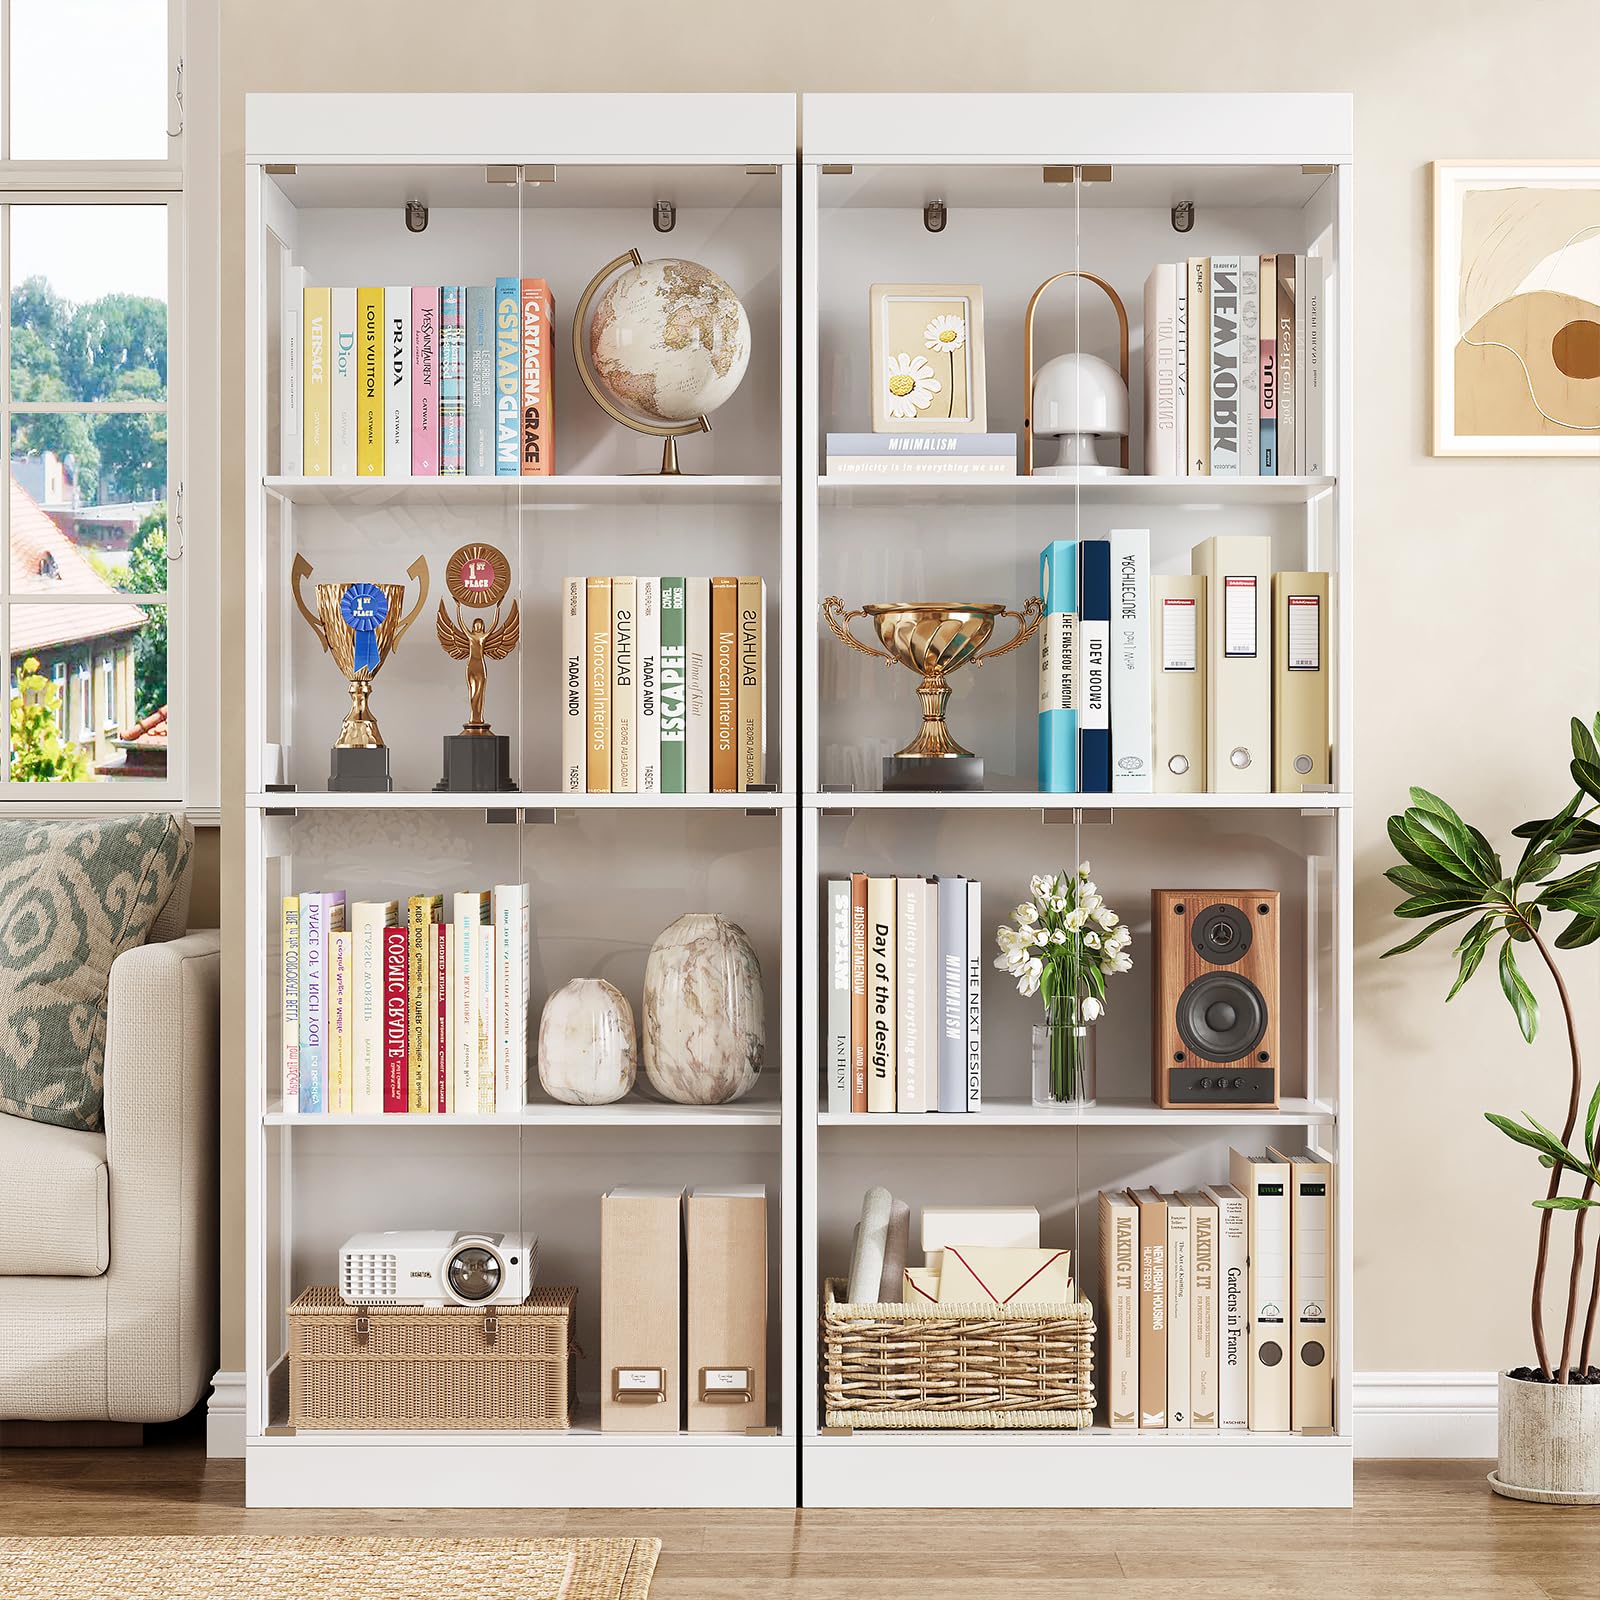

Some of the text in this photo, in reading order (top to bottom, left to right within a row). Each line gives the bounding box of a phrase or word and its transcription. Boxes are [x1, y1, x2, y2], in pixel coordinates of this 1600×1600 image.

[312, 316, 323, 384] VERSACE
[338, 331, 354, 377] Dior
[366, 305, 375, 398] LOUIS VUITTON
[393, 318, 403, 386] PRADA
[472, 350, 481, 408] PIERRE JEANNERET
[482, 359, 490, 395] CORBUSIER
[498, 298, 518, 395] GSTAAD
[524, 301, 540, 407] CARTAGENA
[498, 395, 518, 462] GLAM
[525, 407, 540, 463] GRACE
[889, 438, 957, 450] MINIMALISM
[917, 463, 968, 473] everything
[569, 655, 579, 716] TADAO ANDO
[643, 655, 653, 716] TADAO ANDO
[661, 646, 685, 741] ESCAPEE
[691, 652, 703, 681] Hilma
[691, 693, 703, 717] Klint
[834, 894, 849, 990] STEAM
[853, 906, 864, 995] #DISRUPTMENOW
[872, 923, 889, 1079] Day of the design
[904, 893, 917, 1099] simplicity is in everything we see
[945, 954, 961, 1039] MINIMALISM
[970, 956, 979, 1100] THE NEXT DESIGN
[837, 1035, 846, 1091] IAN HUNT
[856, 1046, 864, 1094] DAVID SMITH
[1116, 1217, 1132, 1289] MAKING IT
[1143, 1246, 1152, 1292] HILARY FRENCH
[1196, 1217, 1211, 1289] MAKING IT
[1153, 1245, 1164, 1330] NEW URBAN HOUSING
[1227, 1267, 1241, 1366] Gardens in France
